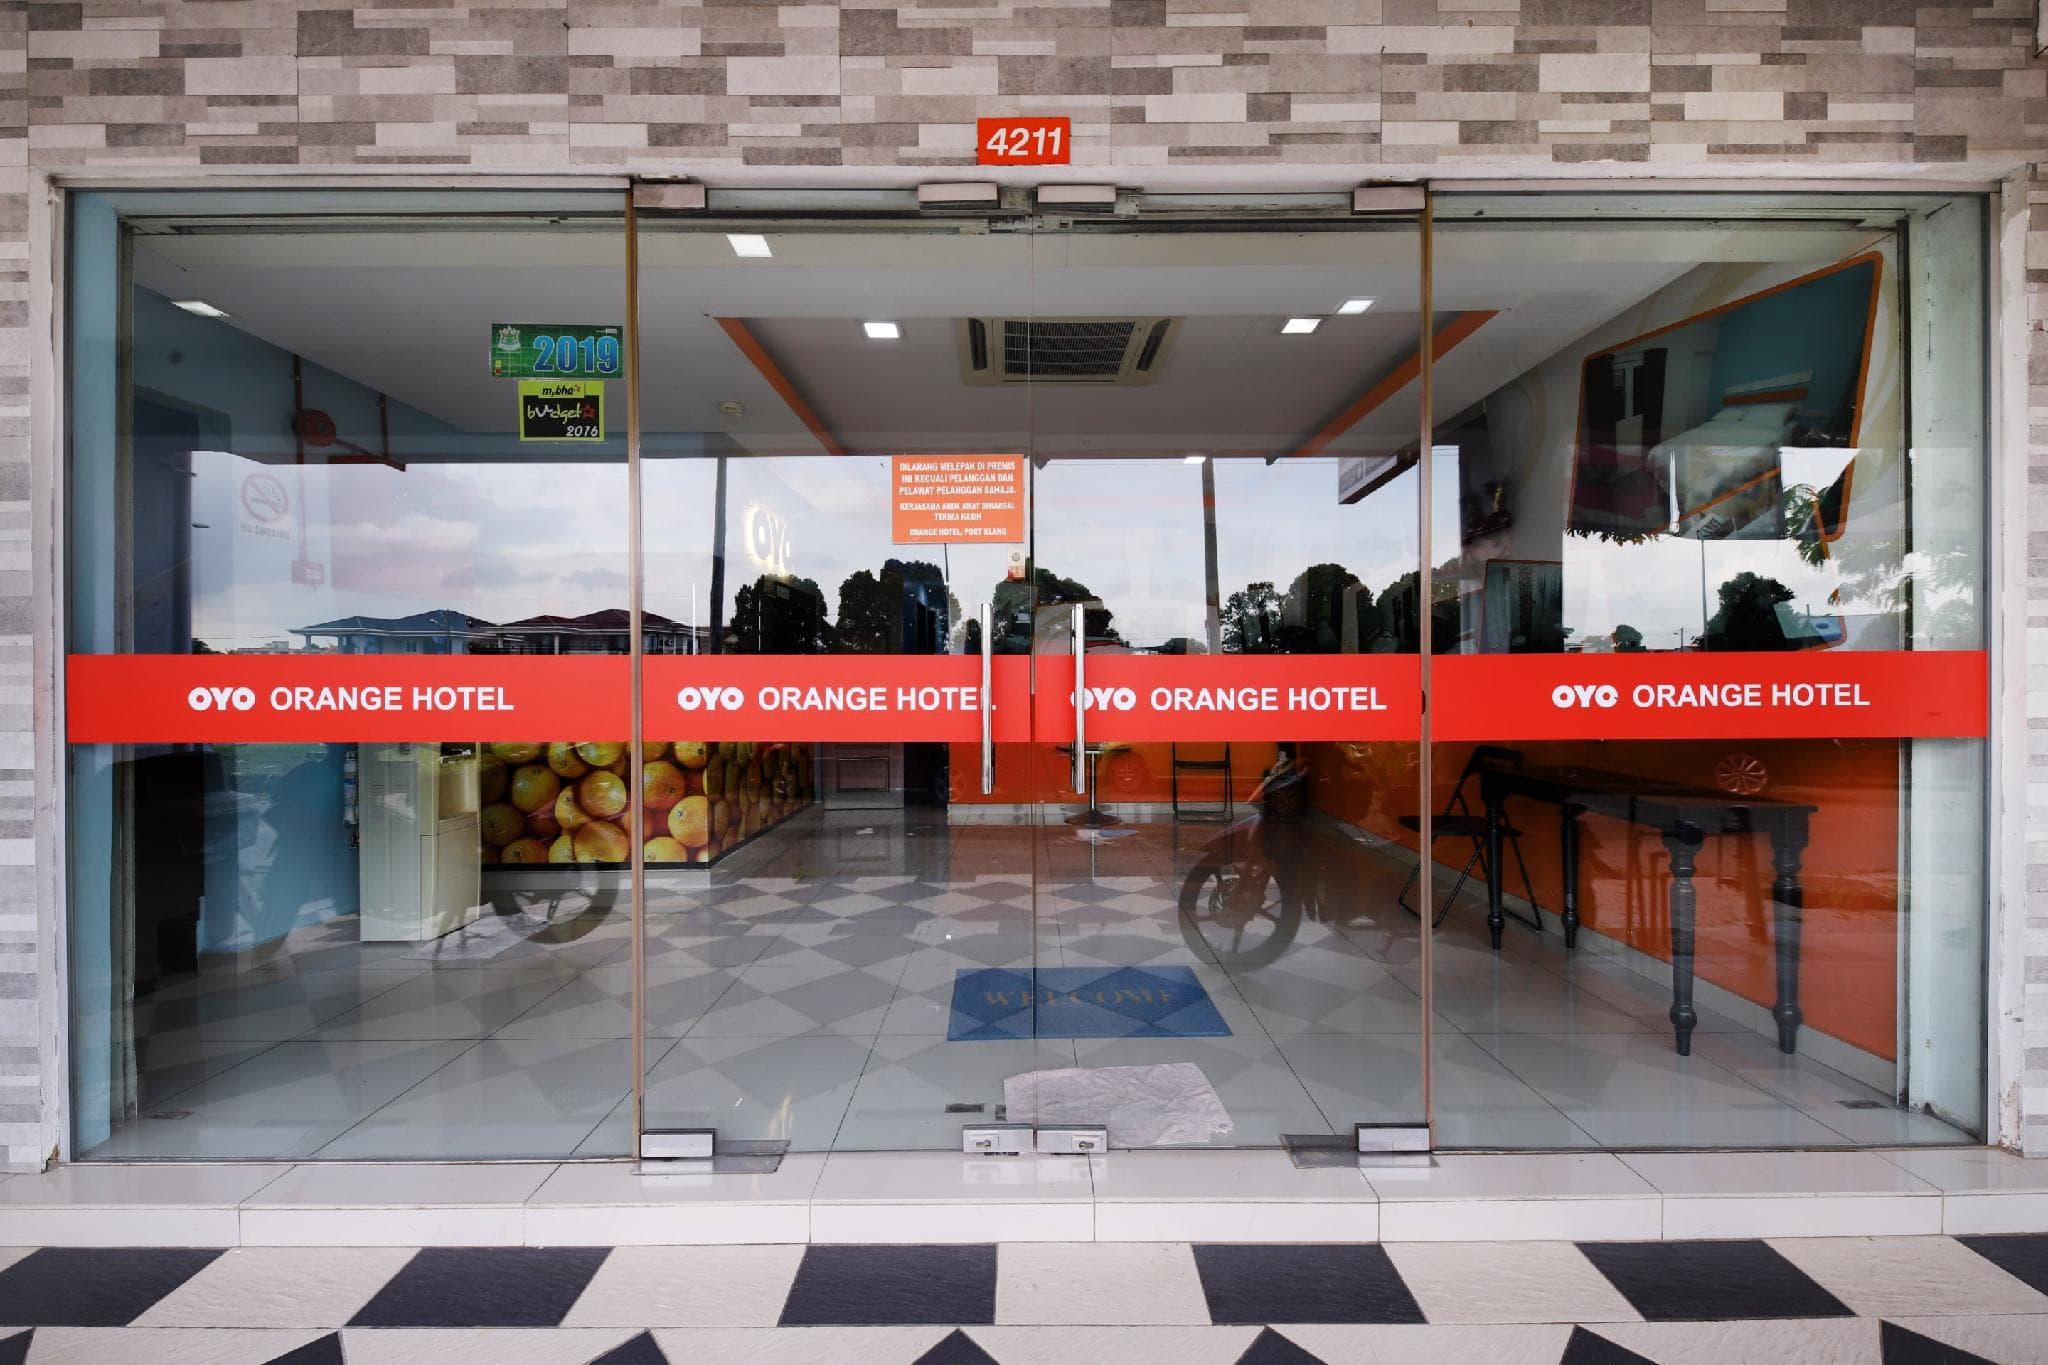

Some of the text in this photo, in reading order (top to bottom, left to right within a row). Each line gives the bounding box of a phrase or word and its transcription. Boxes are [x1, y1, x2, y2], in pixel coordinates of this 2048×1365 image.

[986, 127, 1062, 156] 4211
[533, 335, 619, 373] 2019
[527, 402, 582, 424] budget
[566, 426, 599, 437] 2016
[899, 461, 1016, 472] DILARANG MELEPAK DI PREMIS
[901, 473, 1014, 483] INI KECUALI PELANGGAN DAN
[899, 487, 934, 496] PELAWAT
[936, 486, 983, 495] PELANGGAN
[899, 503, 940, 511] KERJASAMA
[934, 513, 982, 521] TERIMA KASIH
[909, 528, 937, 536] ORANGE
[965, 528, 982, 536] PORT
[984, 528, 1007, 536] KLANG
[187, 686, 514, 711] OYO ORANGE HOTEL
[677, 686, 745, 711] OYO
[758, 686, 888, 711] ORANGE
[1150, 686, 1279, 711] ORANGE
[1288, 686, 1388, 711] HOTEL
[1551, 683, 1871, 709] OYO ORANGE HOTEL
